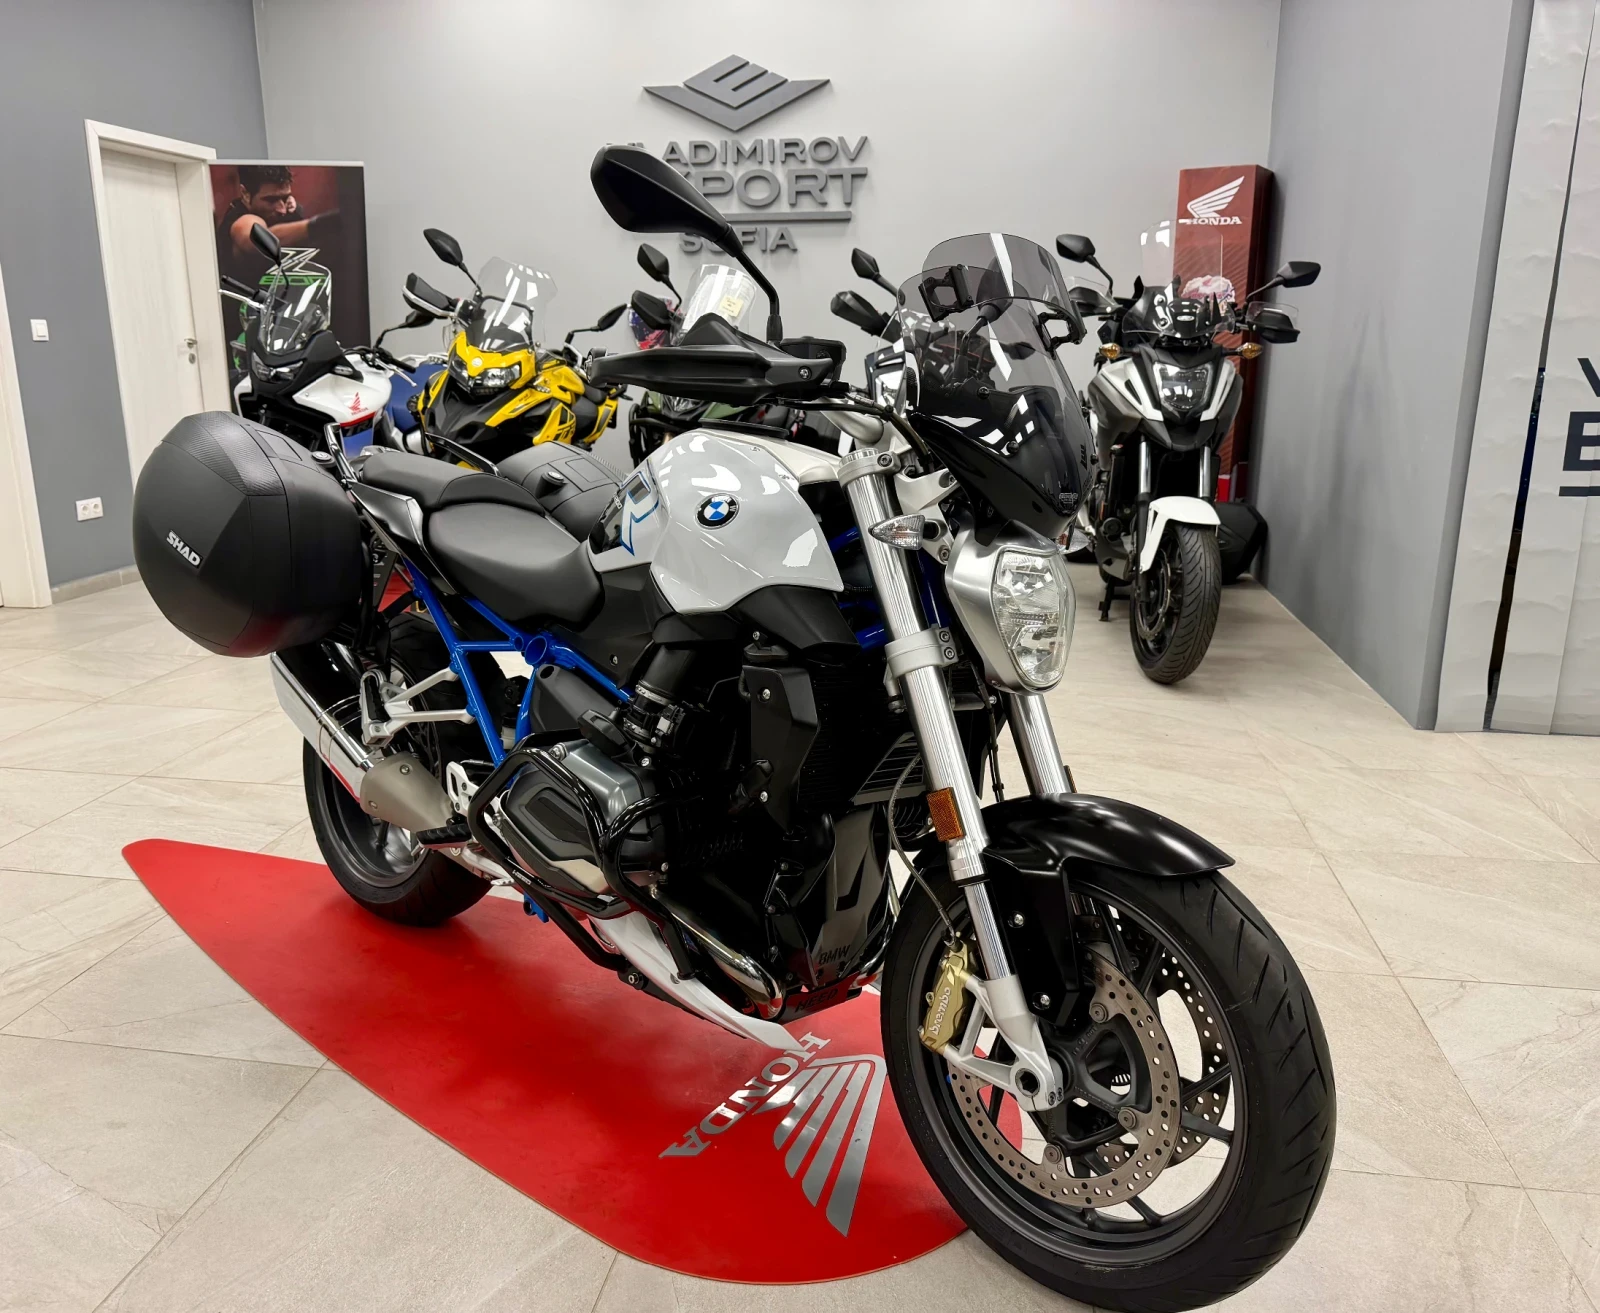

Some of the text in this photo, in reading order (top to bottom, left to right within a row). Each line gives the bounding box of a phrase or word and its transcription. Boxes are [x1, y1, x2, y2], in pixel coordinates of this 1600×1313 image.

[606, 136, 868, 166] ADIMIROV
[684, 167, 868, 208] PORT
[1186, 216, 1243, 226] HONDA
[166, 531, 201, 566] SHAD
[818, 944, 851, 966] BMW
[930, 987, 951, 1036] brembo
[658, 1032, 832, 1159] HONDA
